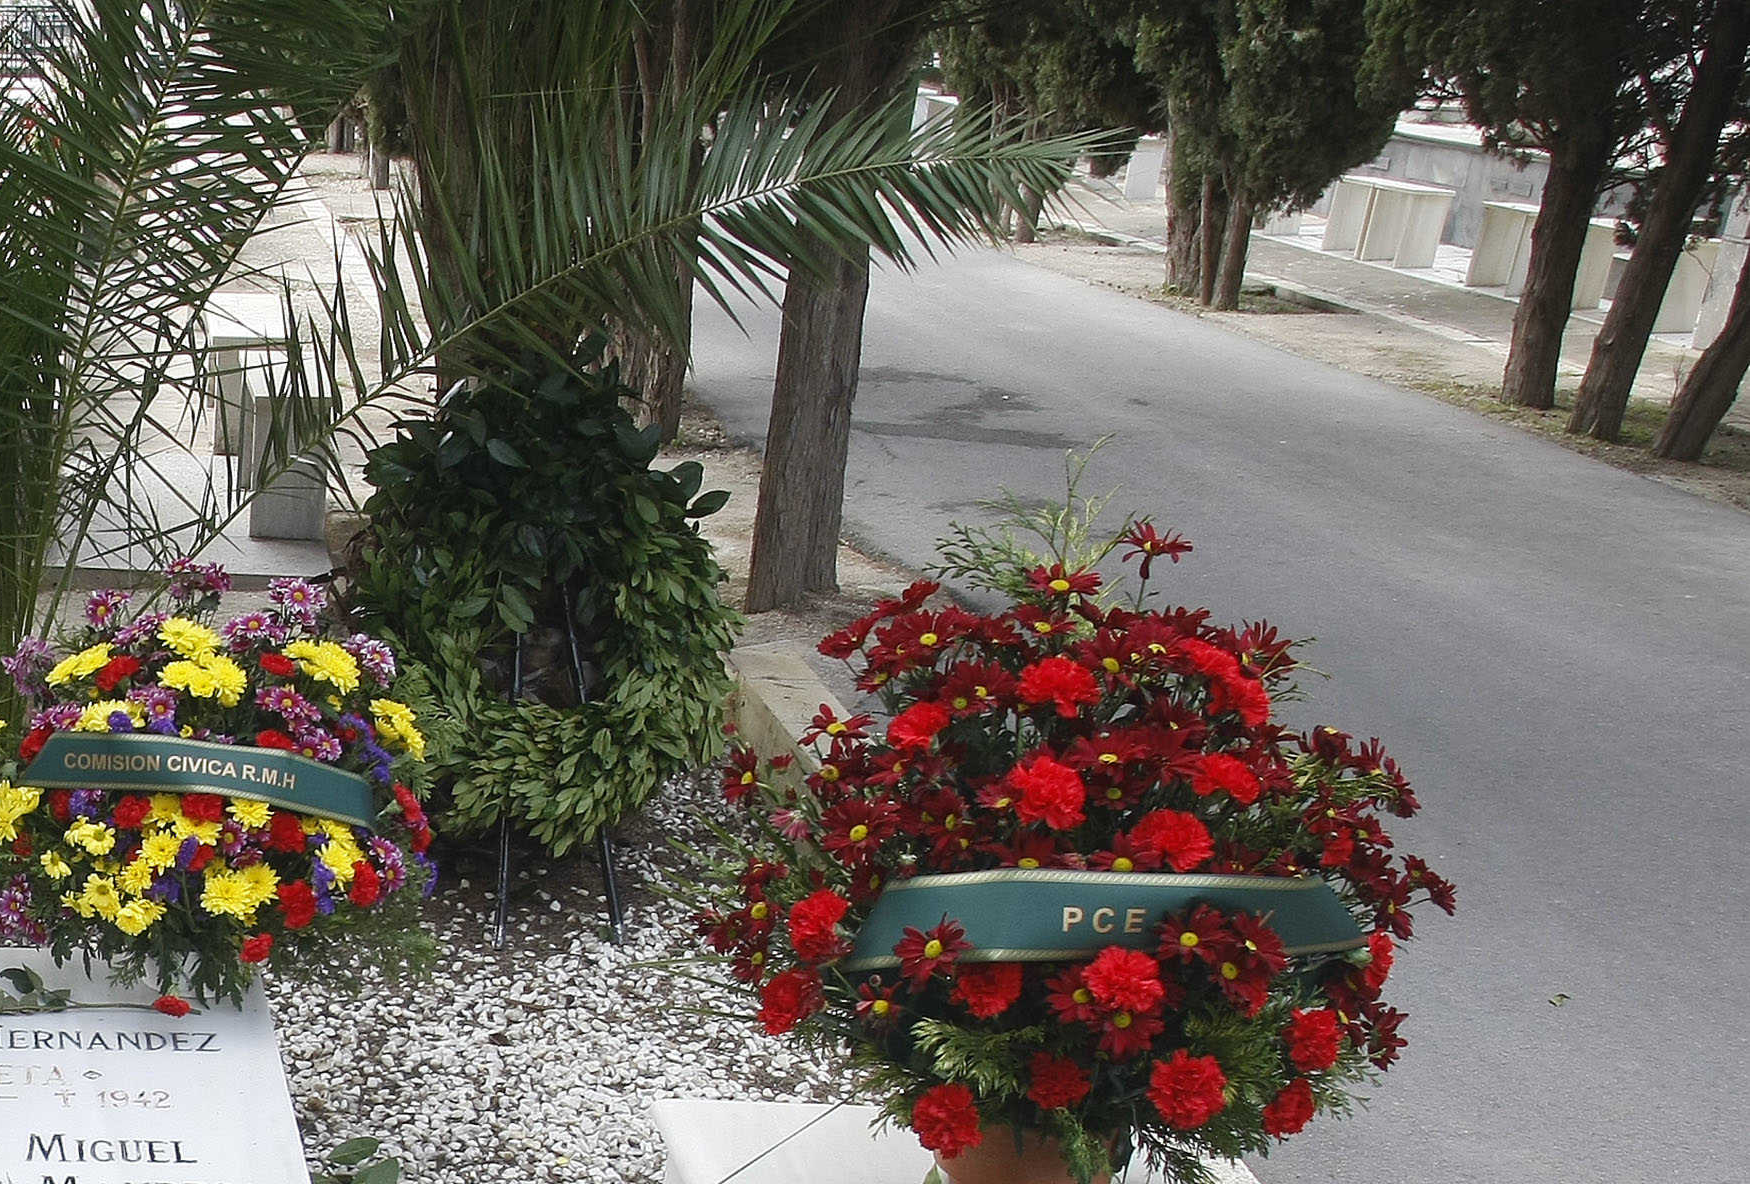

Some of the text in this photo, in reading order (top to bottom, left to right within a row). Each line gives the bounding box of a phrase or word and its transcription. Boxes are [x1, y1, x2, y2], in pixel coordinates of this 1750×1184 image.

[64, 752, 296, 790] COMISION CIVICA R.M.H
[98, 1089, 172, 1109] 1942
[25, 1133, 198, 1163] MIGUEL
